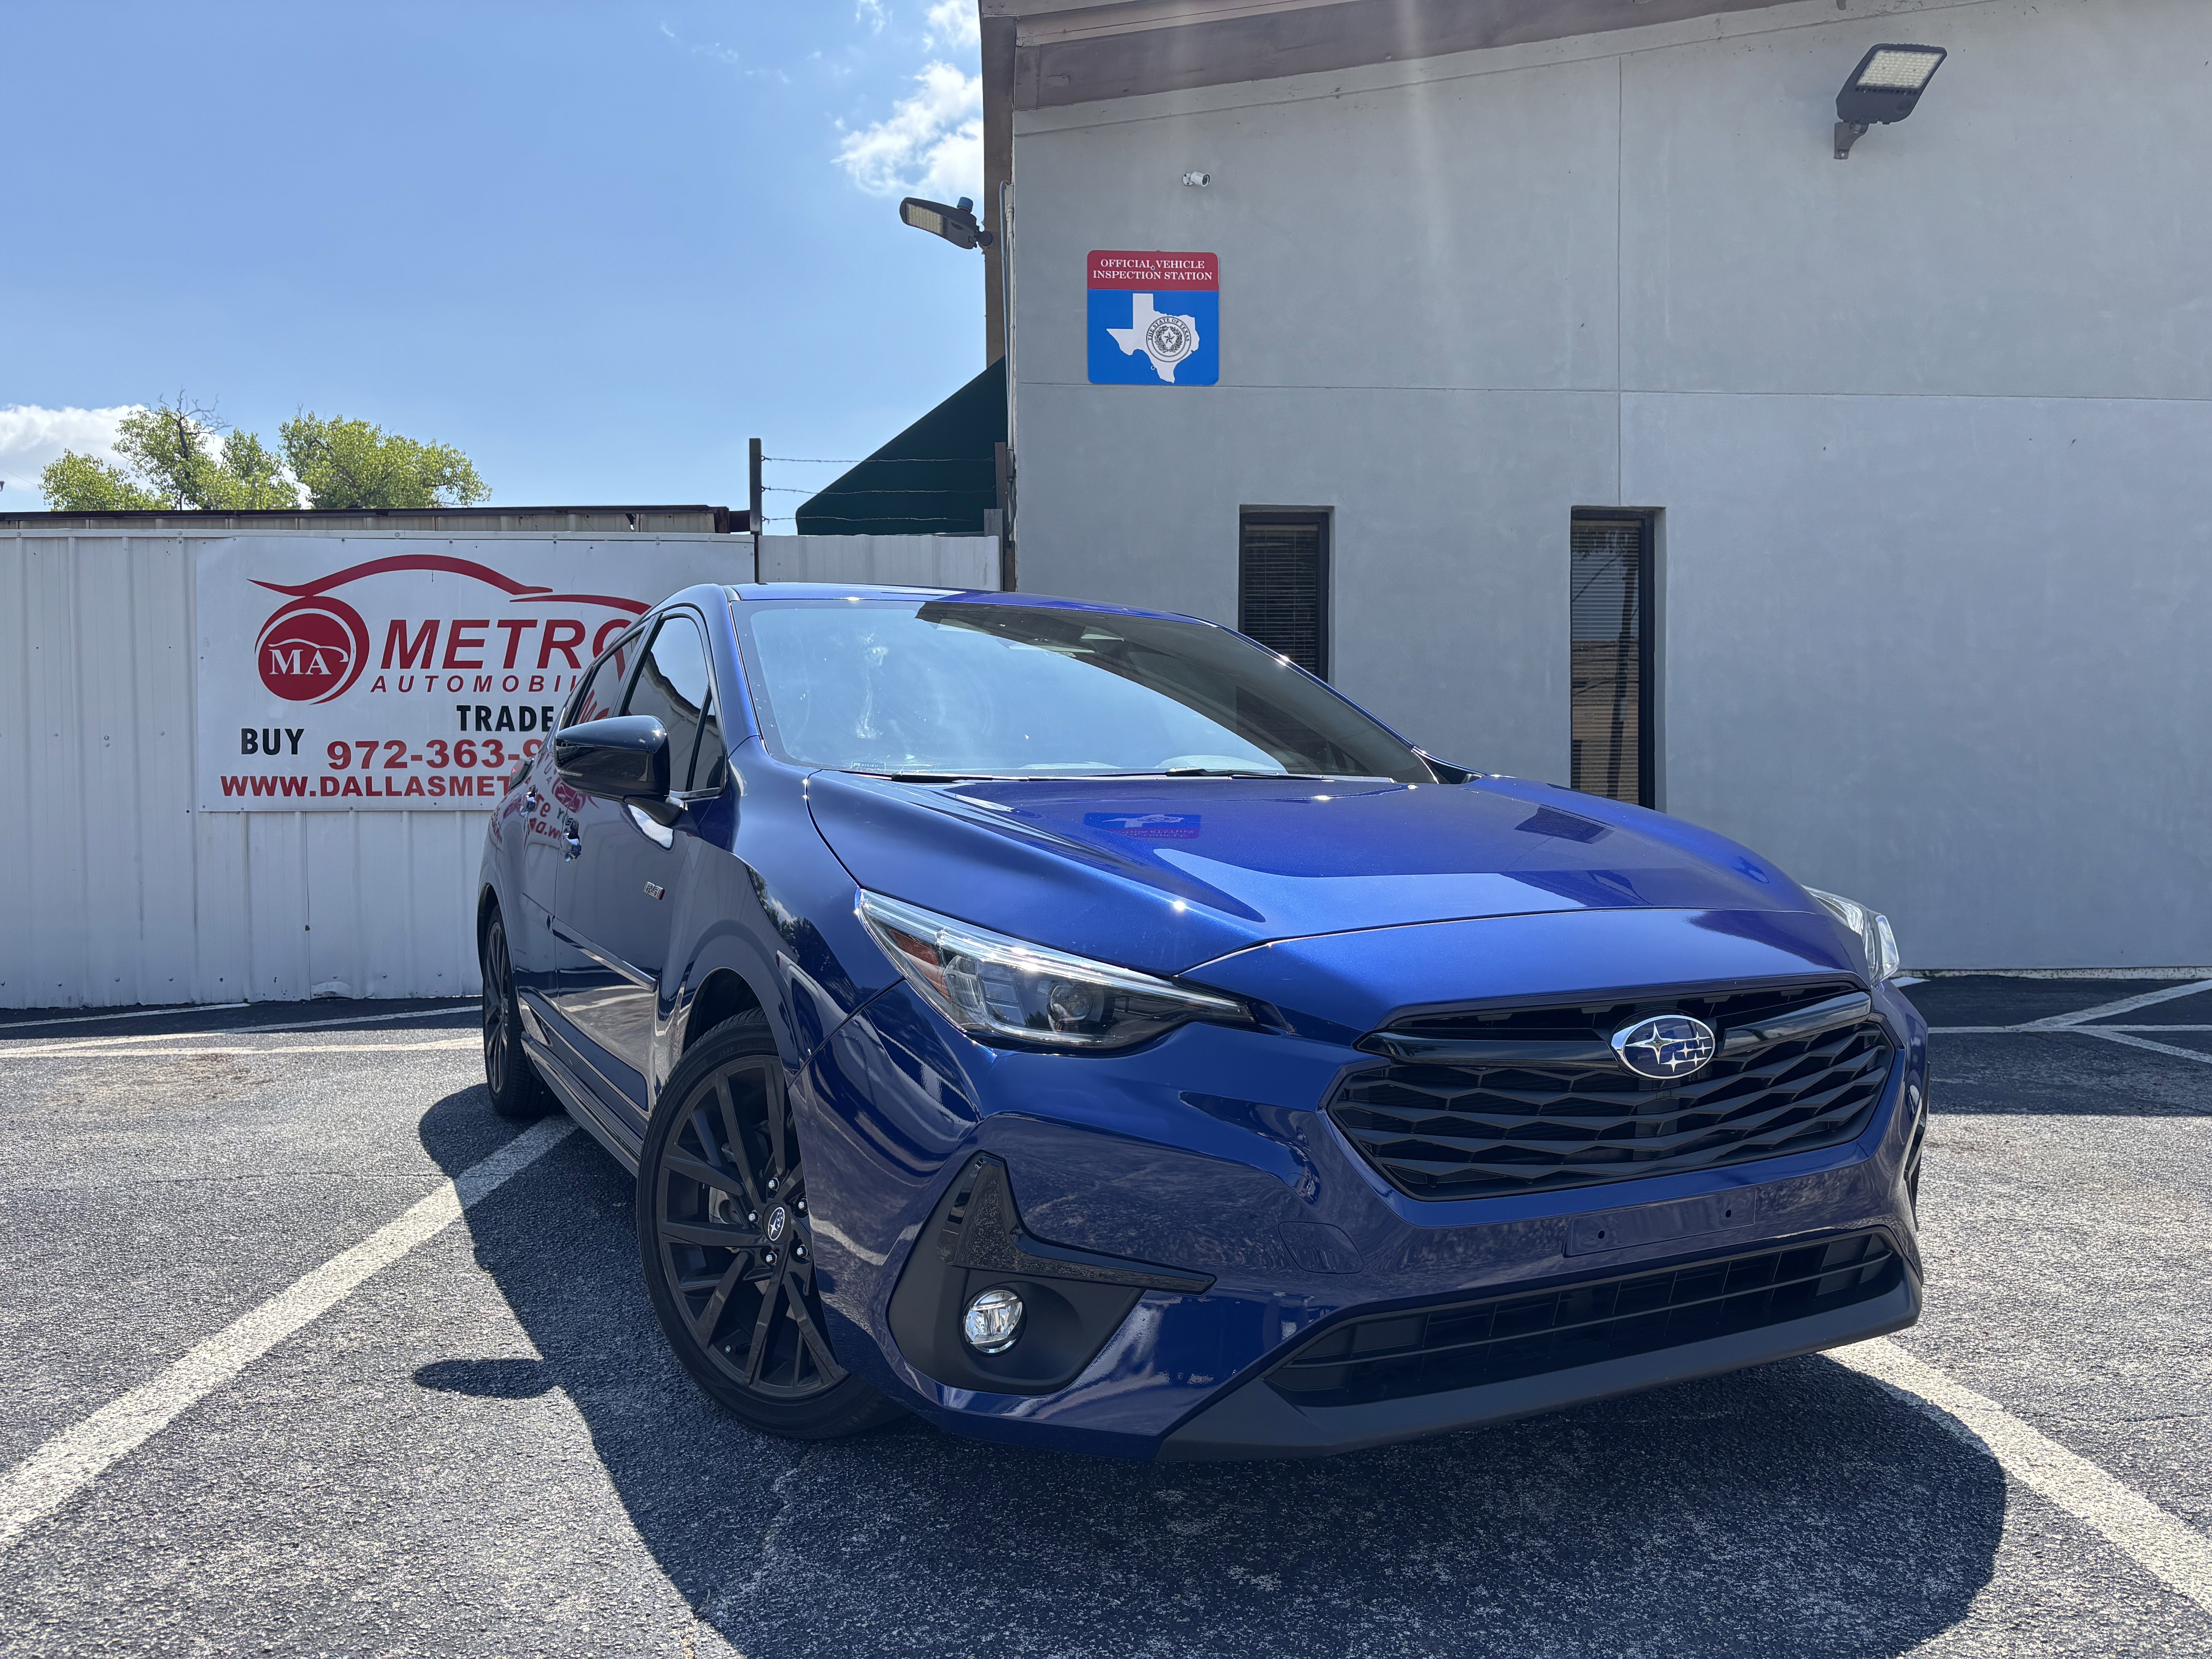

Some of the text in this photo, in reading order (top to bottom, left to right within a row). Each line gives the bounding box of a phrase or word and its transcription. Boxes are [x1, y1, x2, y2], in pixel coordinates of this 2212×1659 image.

[1093, 270, 1212, 280] INSPECTION STATION
[1100, 259, 1205, 269] OFFICIAL VEHICLE
[1152, 318, 1170, 328] STATE
[1180, 323, 1190, 342] TEXAS
[268, 649, 331, 675] MA
[456, 705, 554, 732] TRADE
[241, 728, 305, 755] BUY
[645, 882, 661, 897] RS
